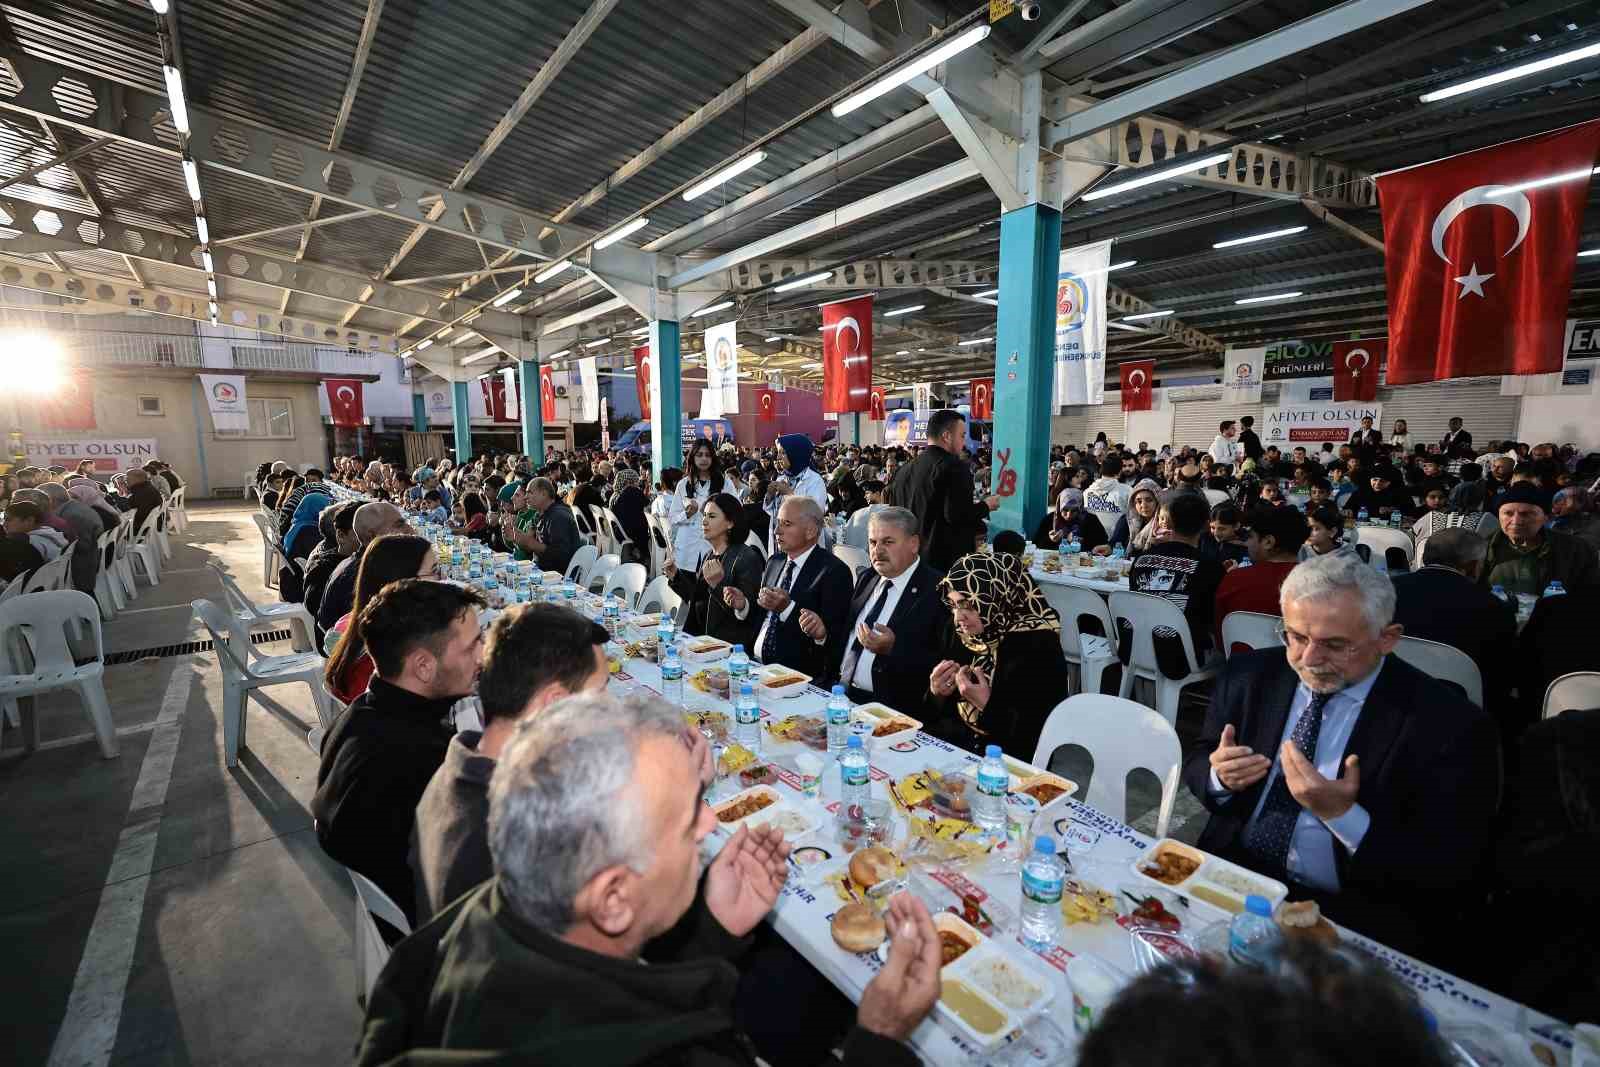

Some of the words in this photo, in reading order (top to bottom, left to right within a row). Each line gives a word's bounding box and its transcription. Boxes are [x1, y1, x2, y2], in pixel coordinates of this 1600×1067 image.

[1323, 407, 1377, 421] OLSUN
[17, 442, 80, 455] FİYET
[86, 442, 151, 456] OLSUN
